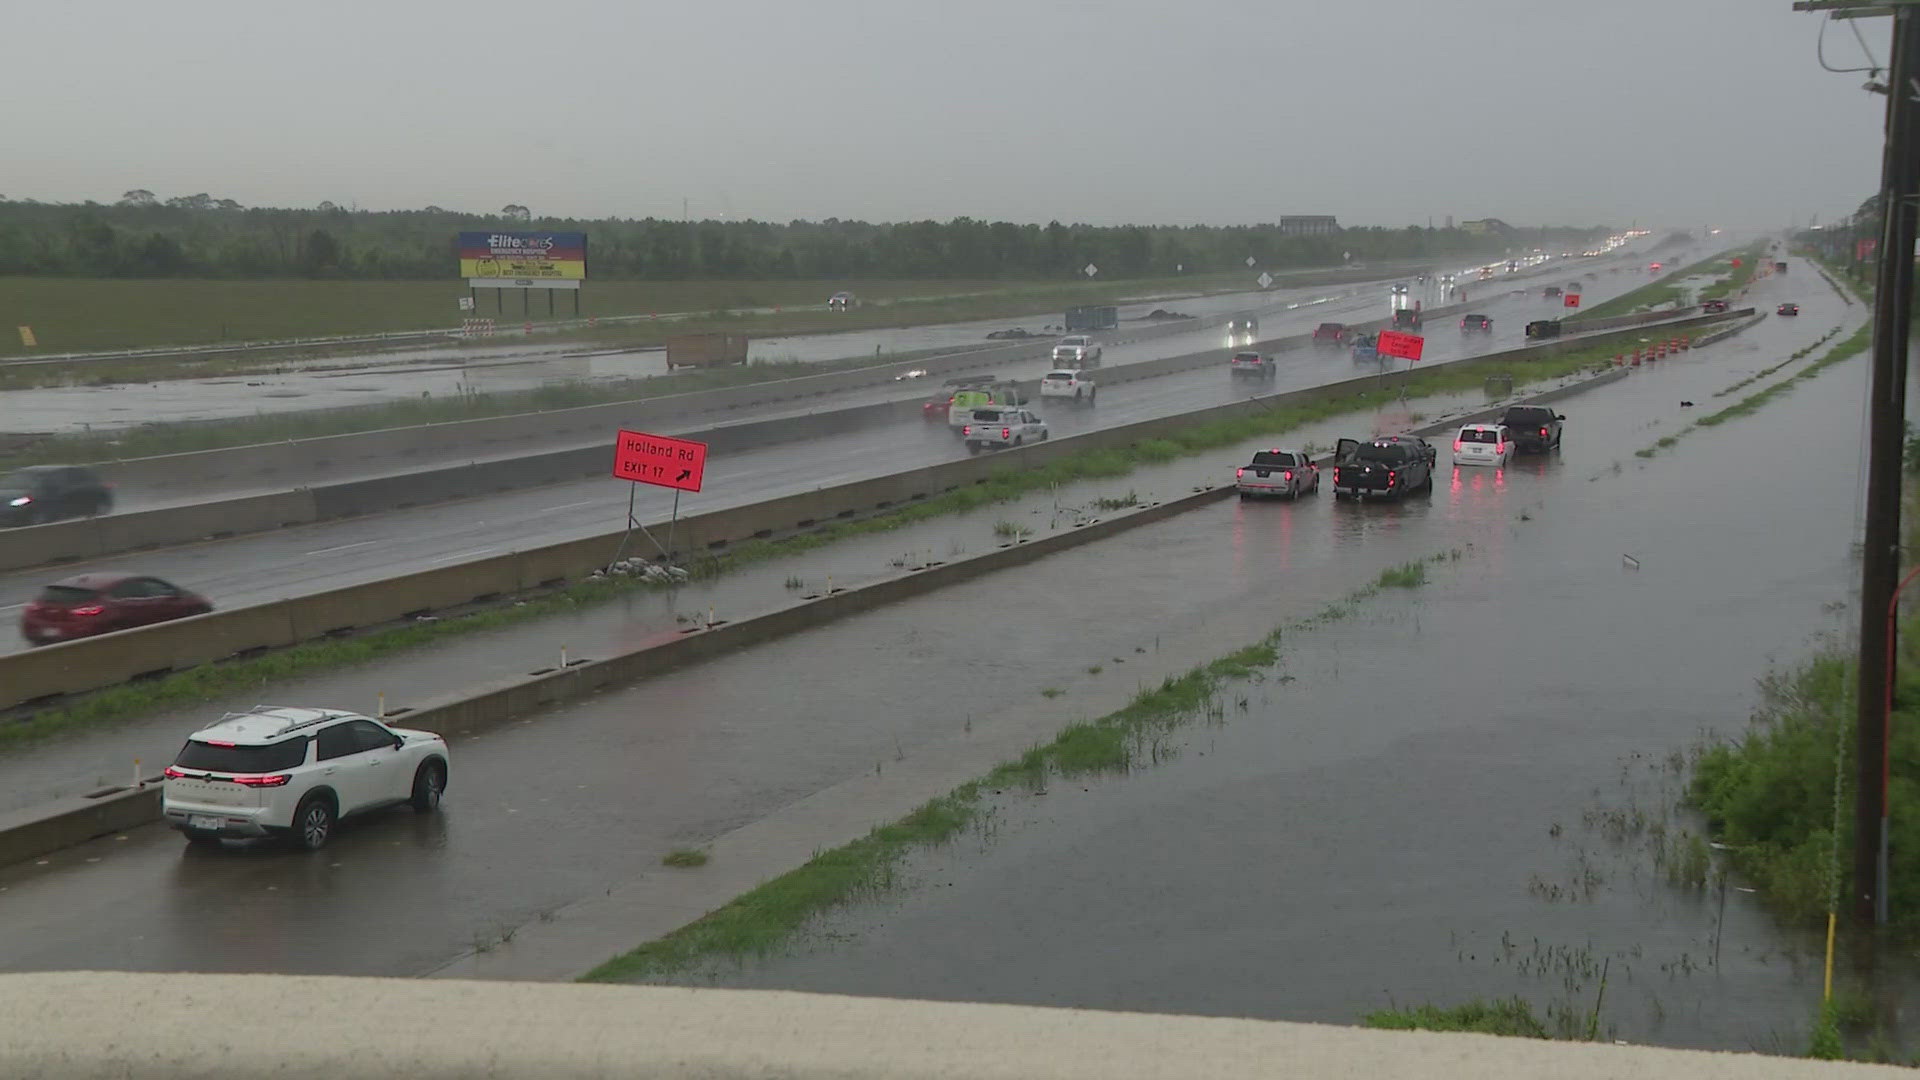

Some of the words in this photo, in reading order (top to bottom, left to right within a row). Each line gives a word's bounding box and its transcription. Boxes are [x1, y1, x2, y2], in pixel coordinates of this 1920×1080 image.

[627, 440, 673, 457] Holland
[678, 449, 694, 461] Rd
[623, 461, 647, 475] EXIT
[653, 466, 664, 478] 17
